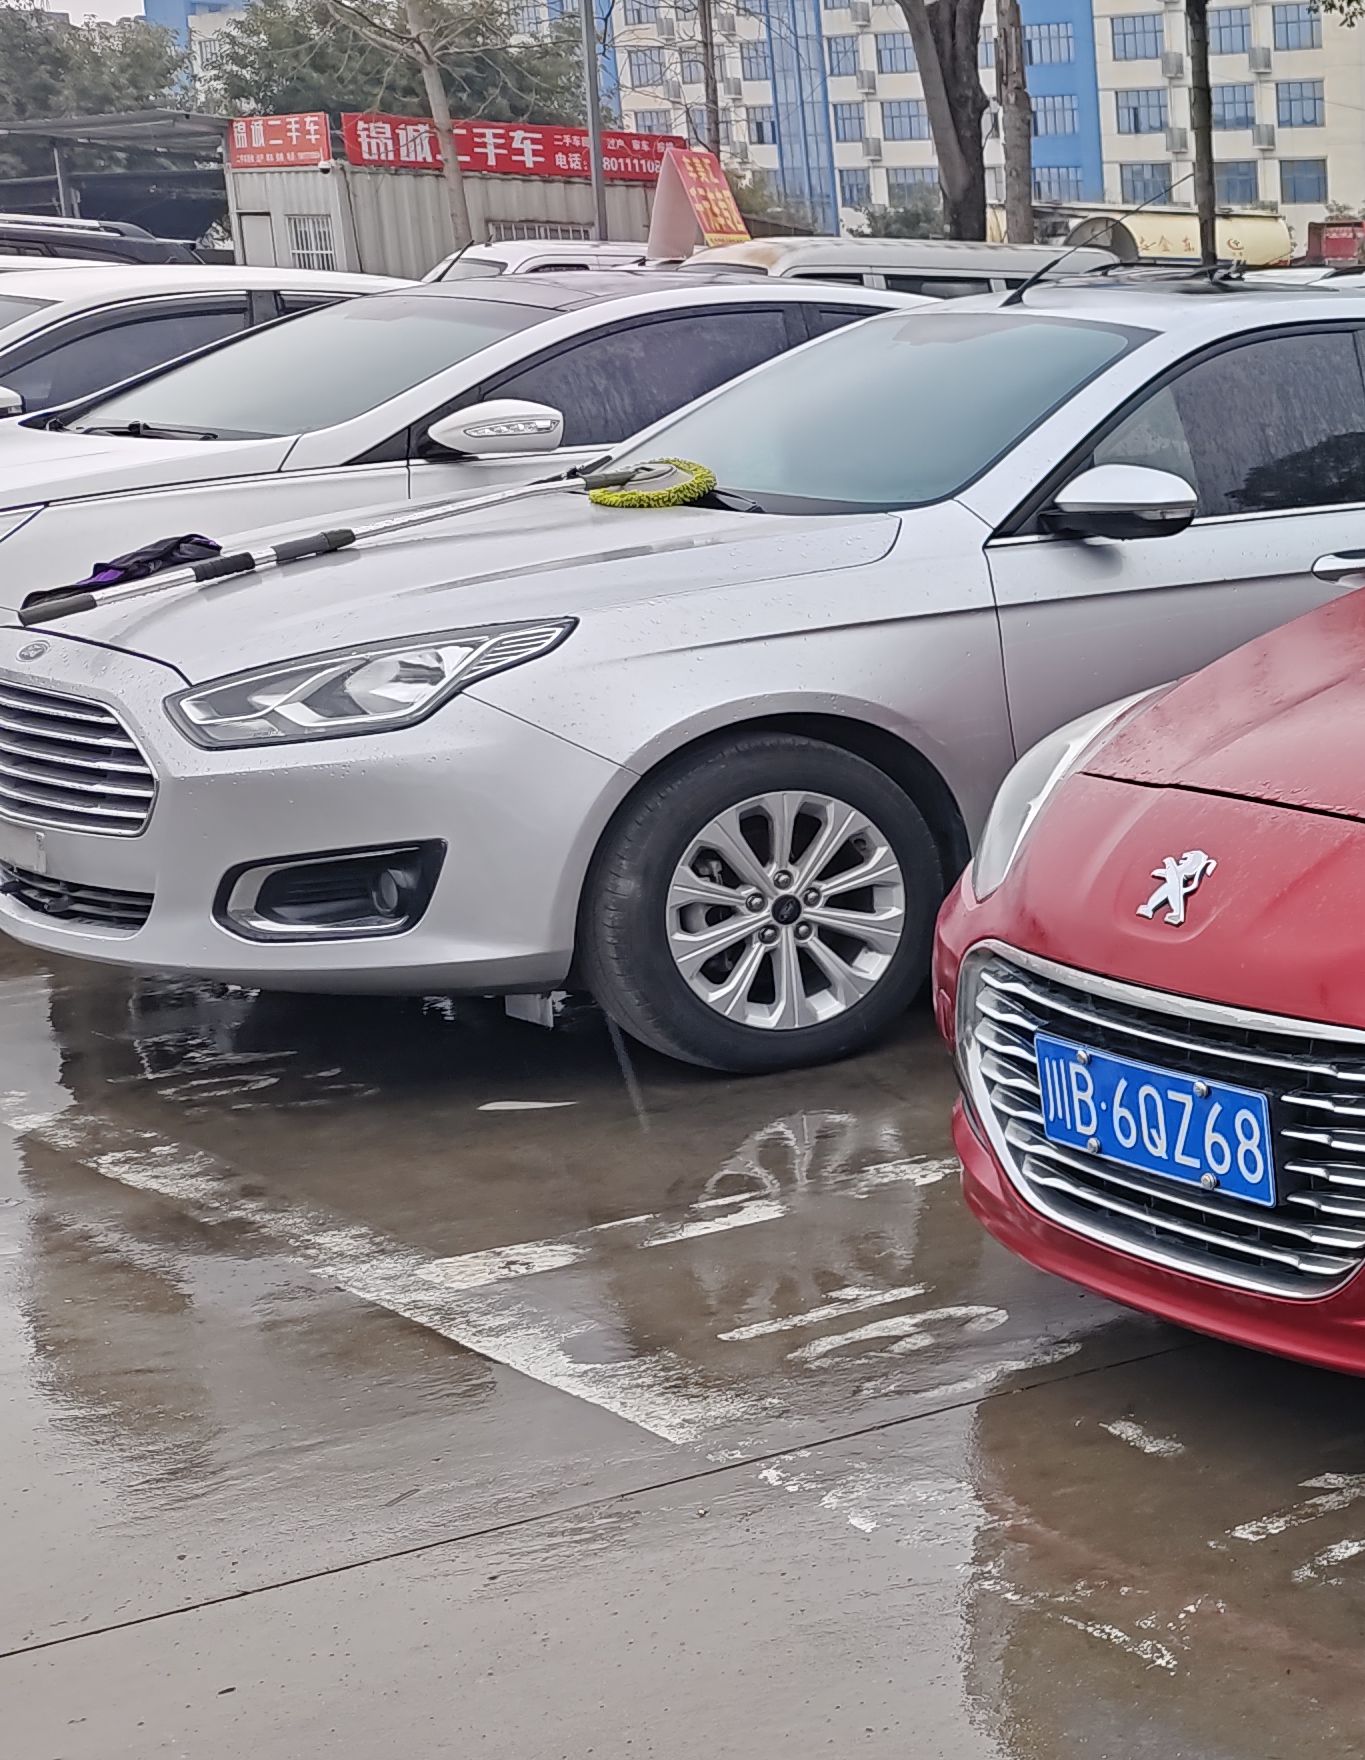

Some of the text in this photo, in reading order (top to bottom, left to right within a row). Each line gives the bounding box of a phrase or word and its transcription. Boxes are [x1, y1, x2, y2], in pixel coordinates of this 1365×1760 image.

[357, 121, 545, 168] 锦诚二手车
[1044, 1057, 1265, 1184] 川B·6QZ68
